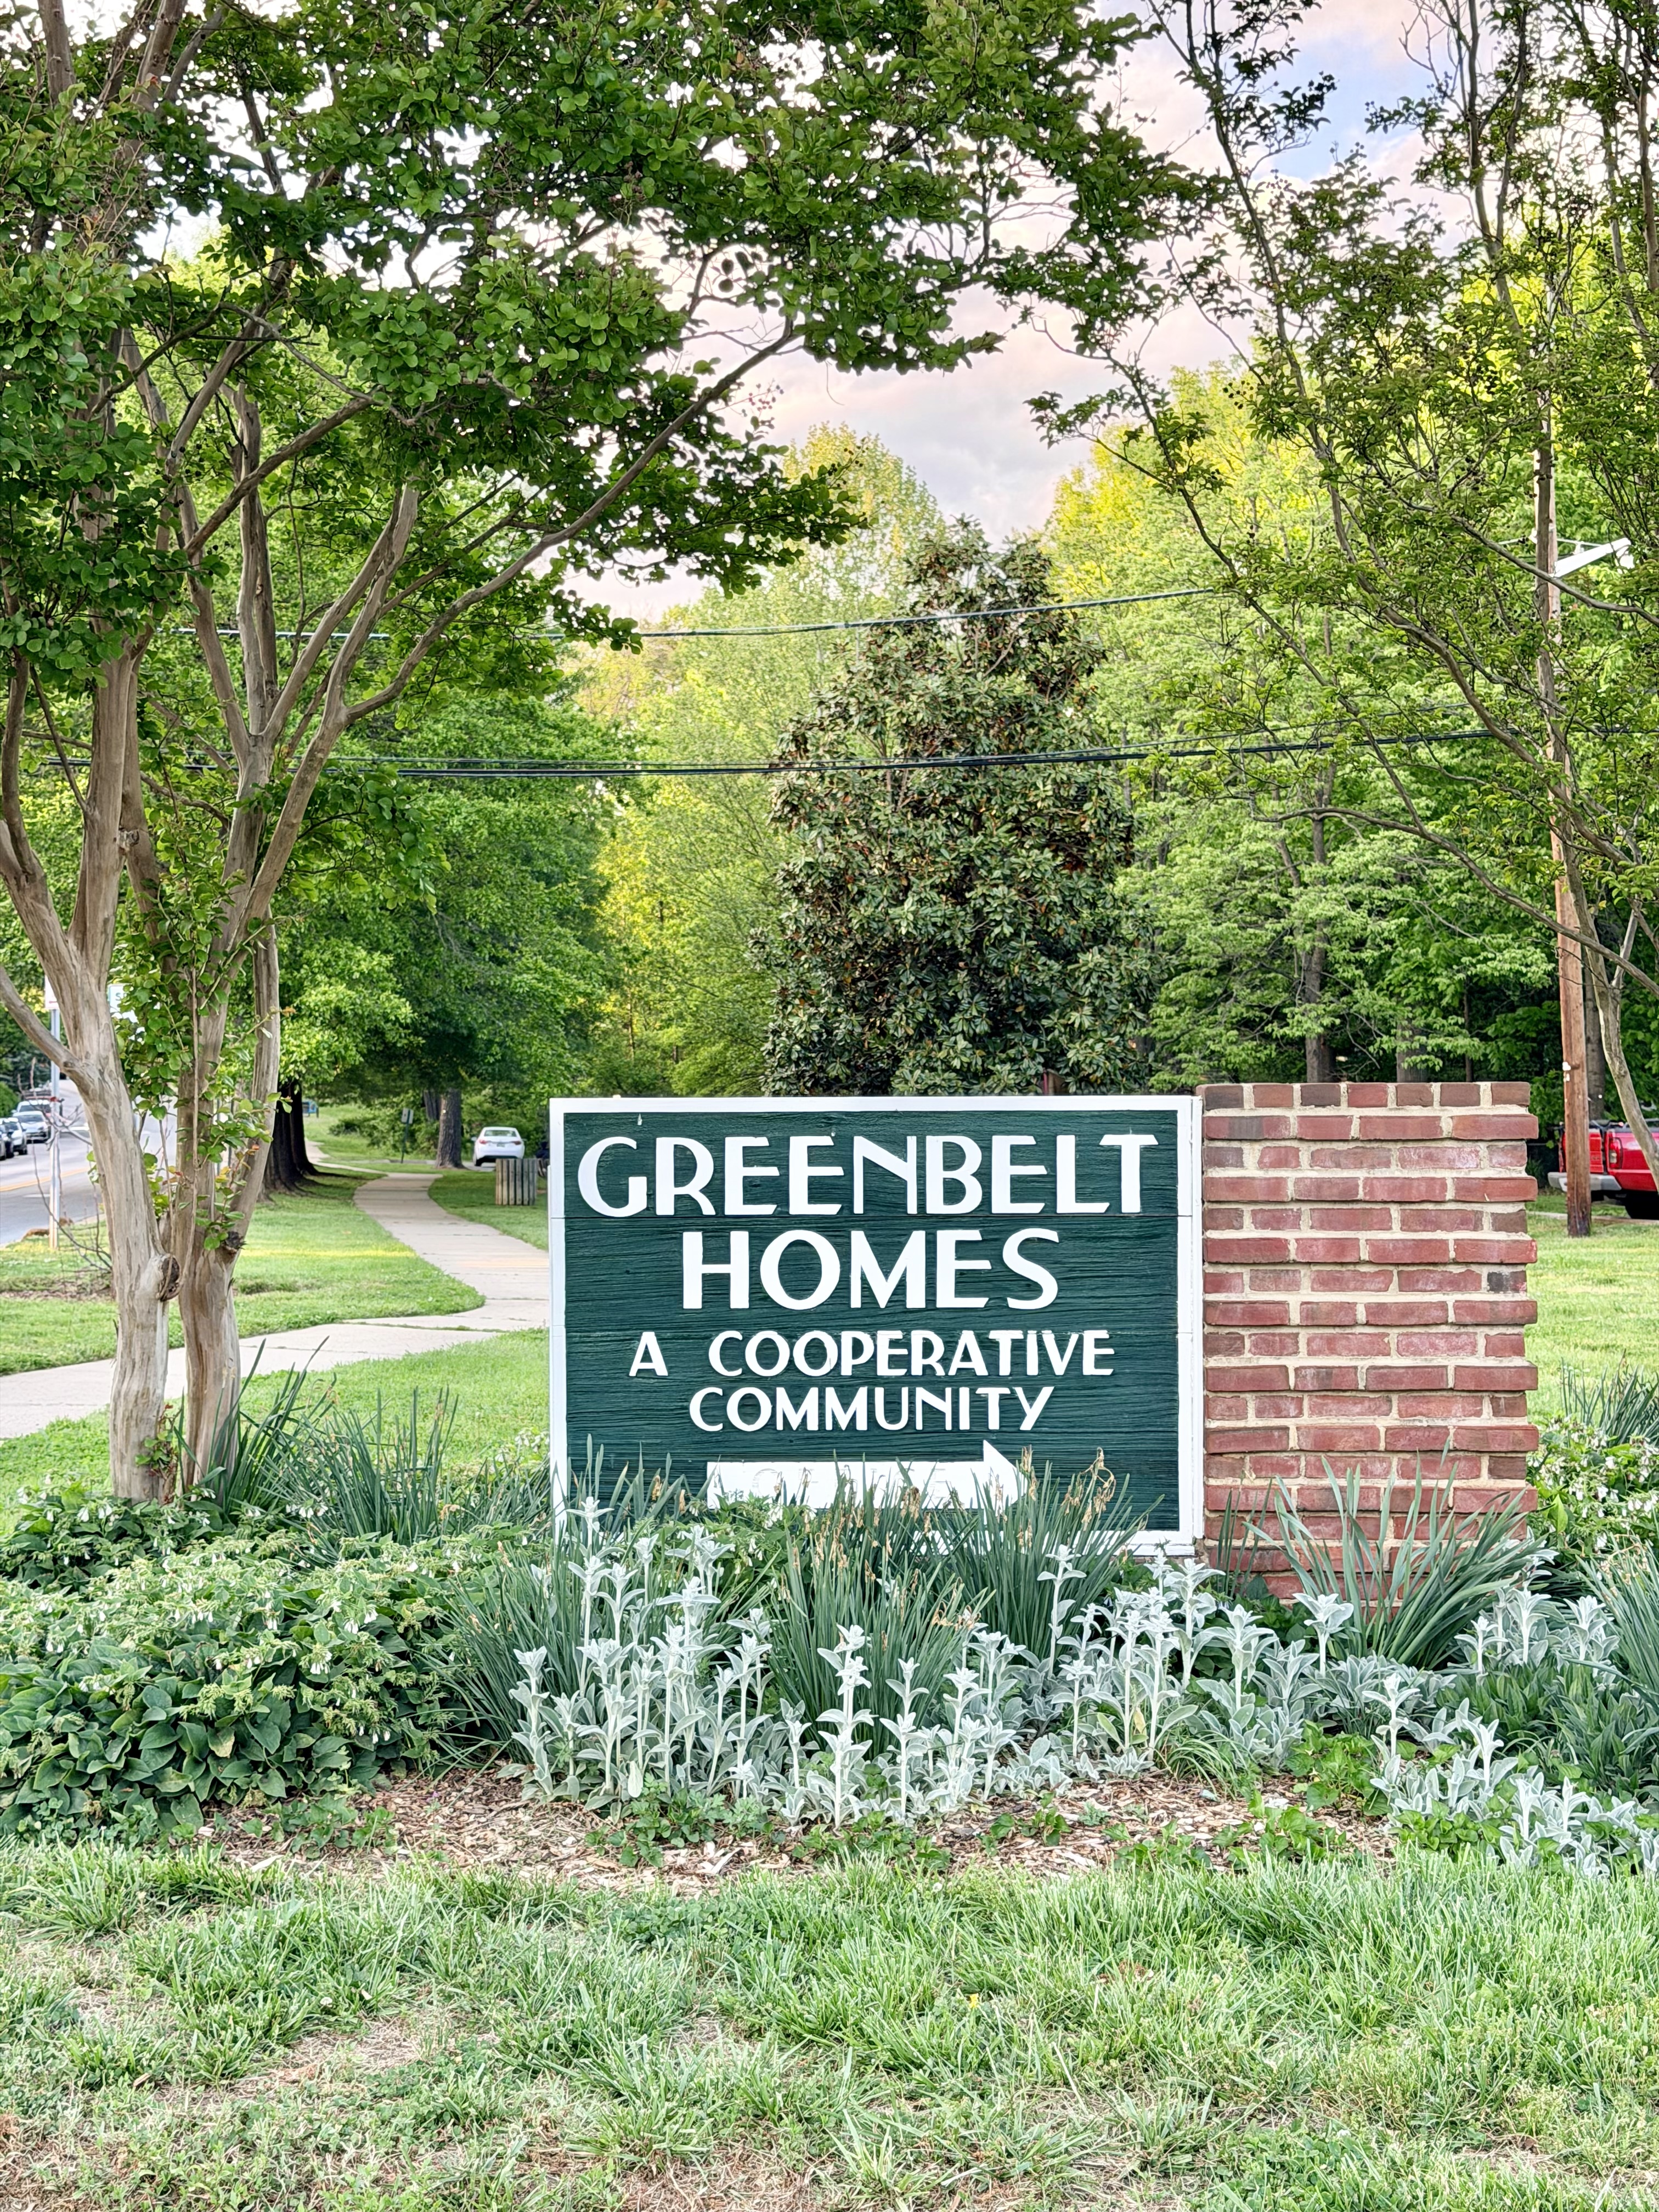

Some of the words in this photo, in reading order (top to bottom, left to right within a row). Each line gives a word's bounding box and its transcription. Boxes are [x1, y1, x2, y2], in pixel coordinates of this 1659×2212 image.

[578, 1134, 1159, 1217] GREENBELT
[682, 1228, 1059, 1310] HOMES
[629, 1331, 668, 1376] A
[708, 1330, 1115, 1376] COOPERATIVE
[689, 1386, 1054, 1431] COMMUNITY
